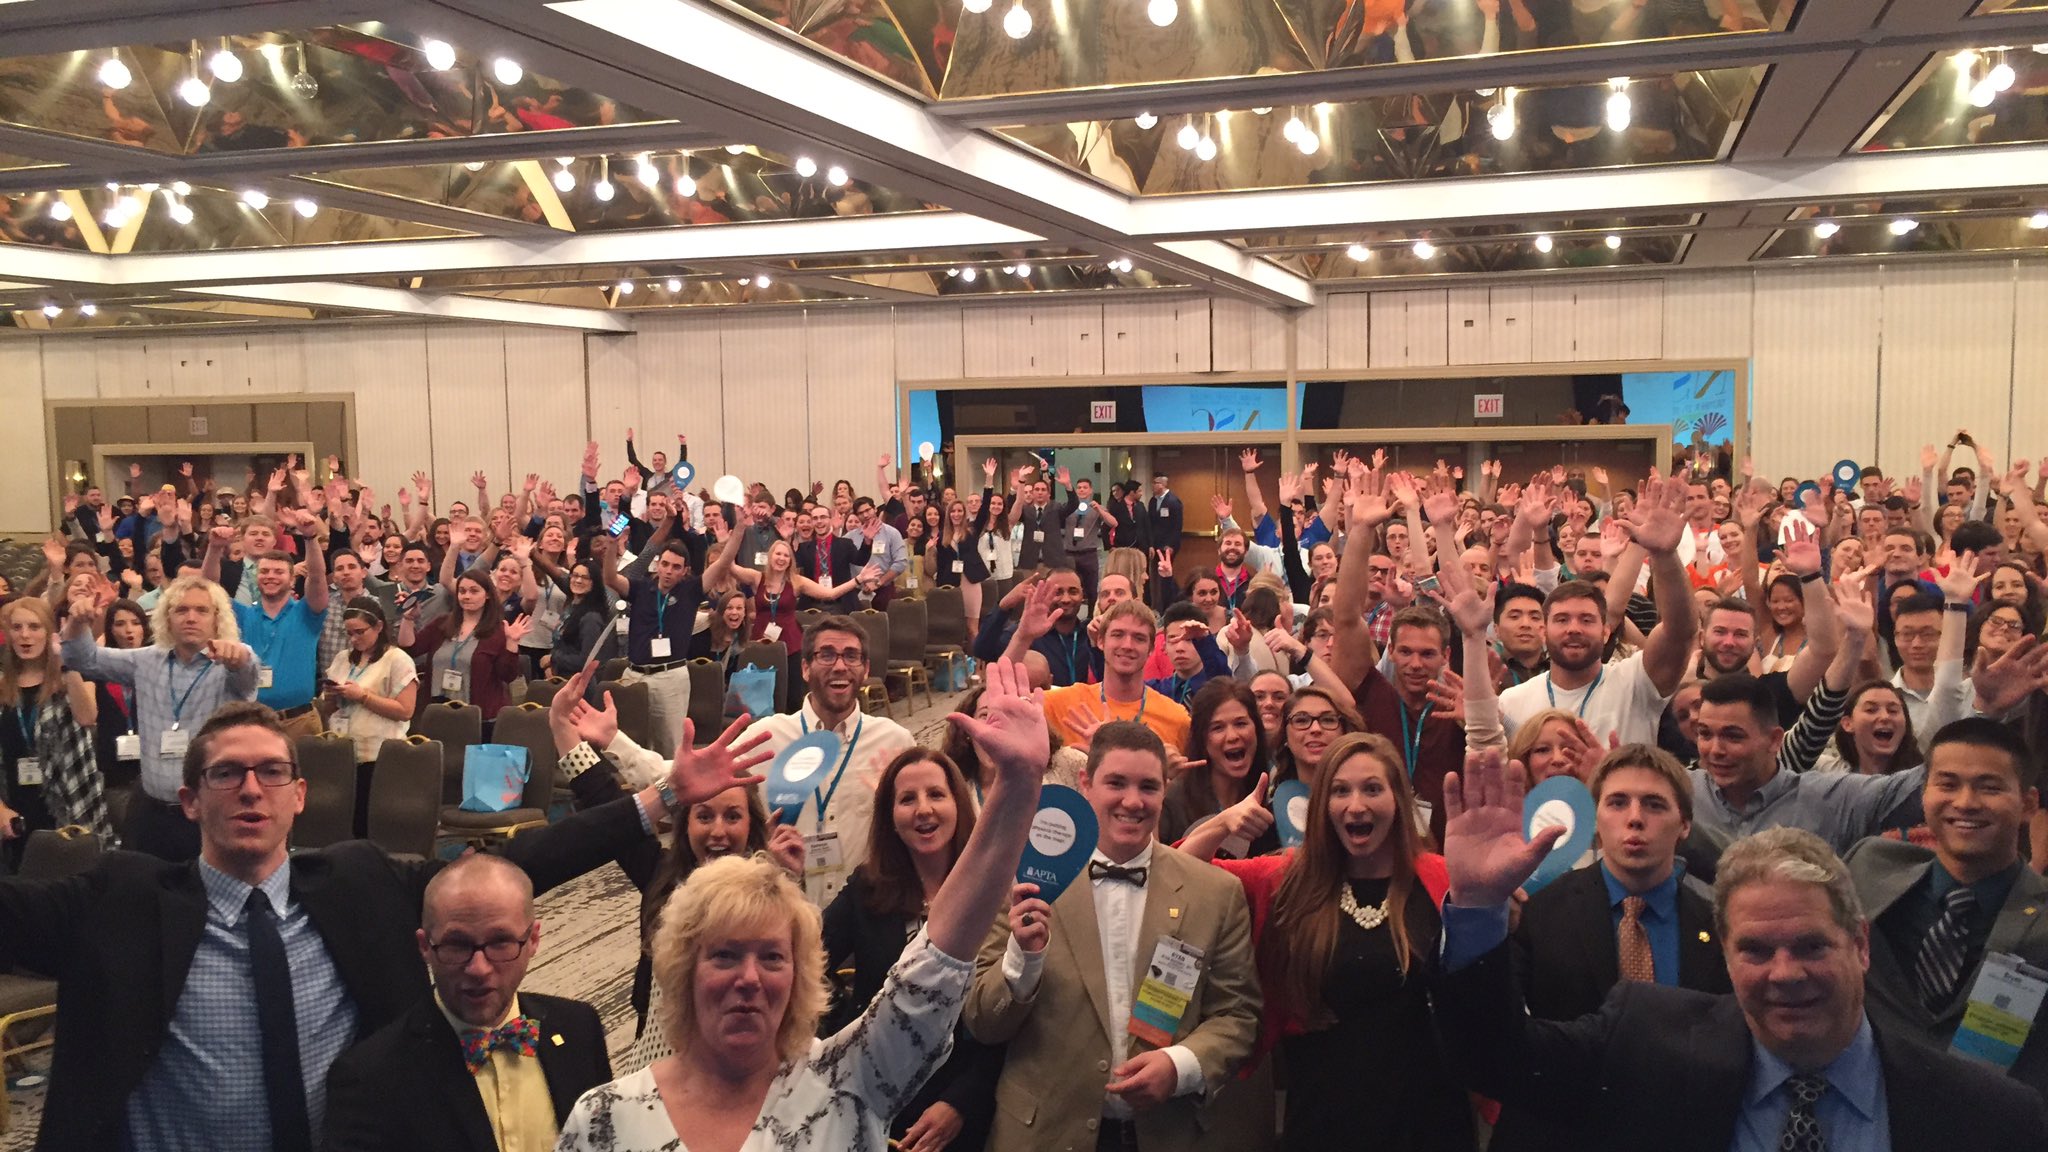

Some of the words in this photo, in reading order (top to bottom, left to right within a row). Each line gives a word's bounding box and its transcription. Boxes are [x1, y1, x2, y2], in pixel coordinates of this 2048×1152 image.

[1094, 405, 1112, 419] EXIT
[1478, 398, 1500, 413] EXIT
[1033, 868, 1057, 881] APTA
